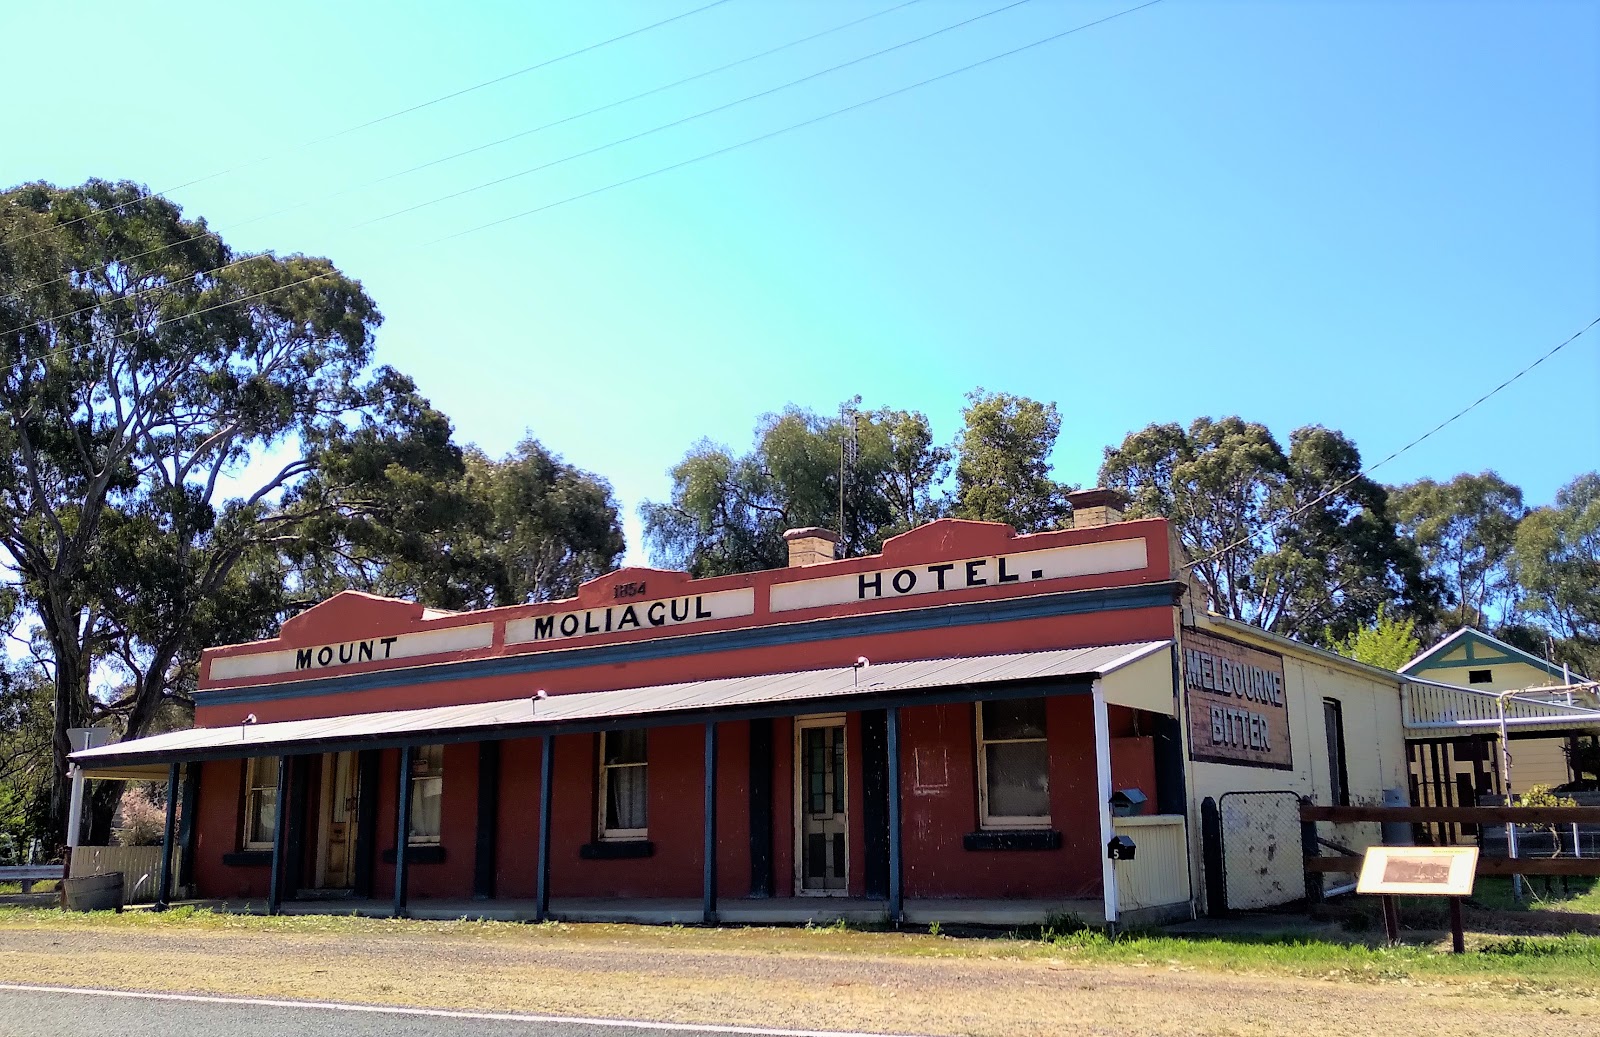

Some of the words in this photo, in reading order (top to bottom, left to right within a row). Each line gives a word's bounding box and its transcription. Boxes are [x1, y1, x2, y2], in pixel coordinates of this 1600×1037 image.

[296, 637, 398, 670] MOUNT
[534, 597, 712, 639] MOLIAGUL
[859, 558, 1042, 598] HOTEL.
[613, 581, 646, 597] 1854
[1185, 648, 1283, 707] MELBOURNE
[1210, 704, 1271, 751] BITTER
